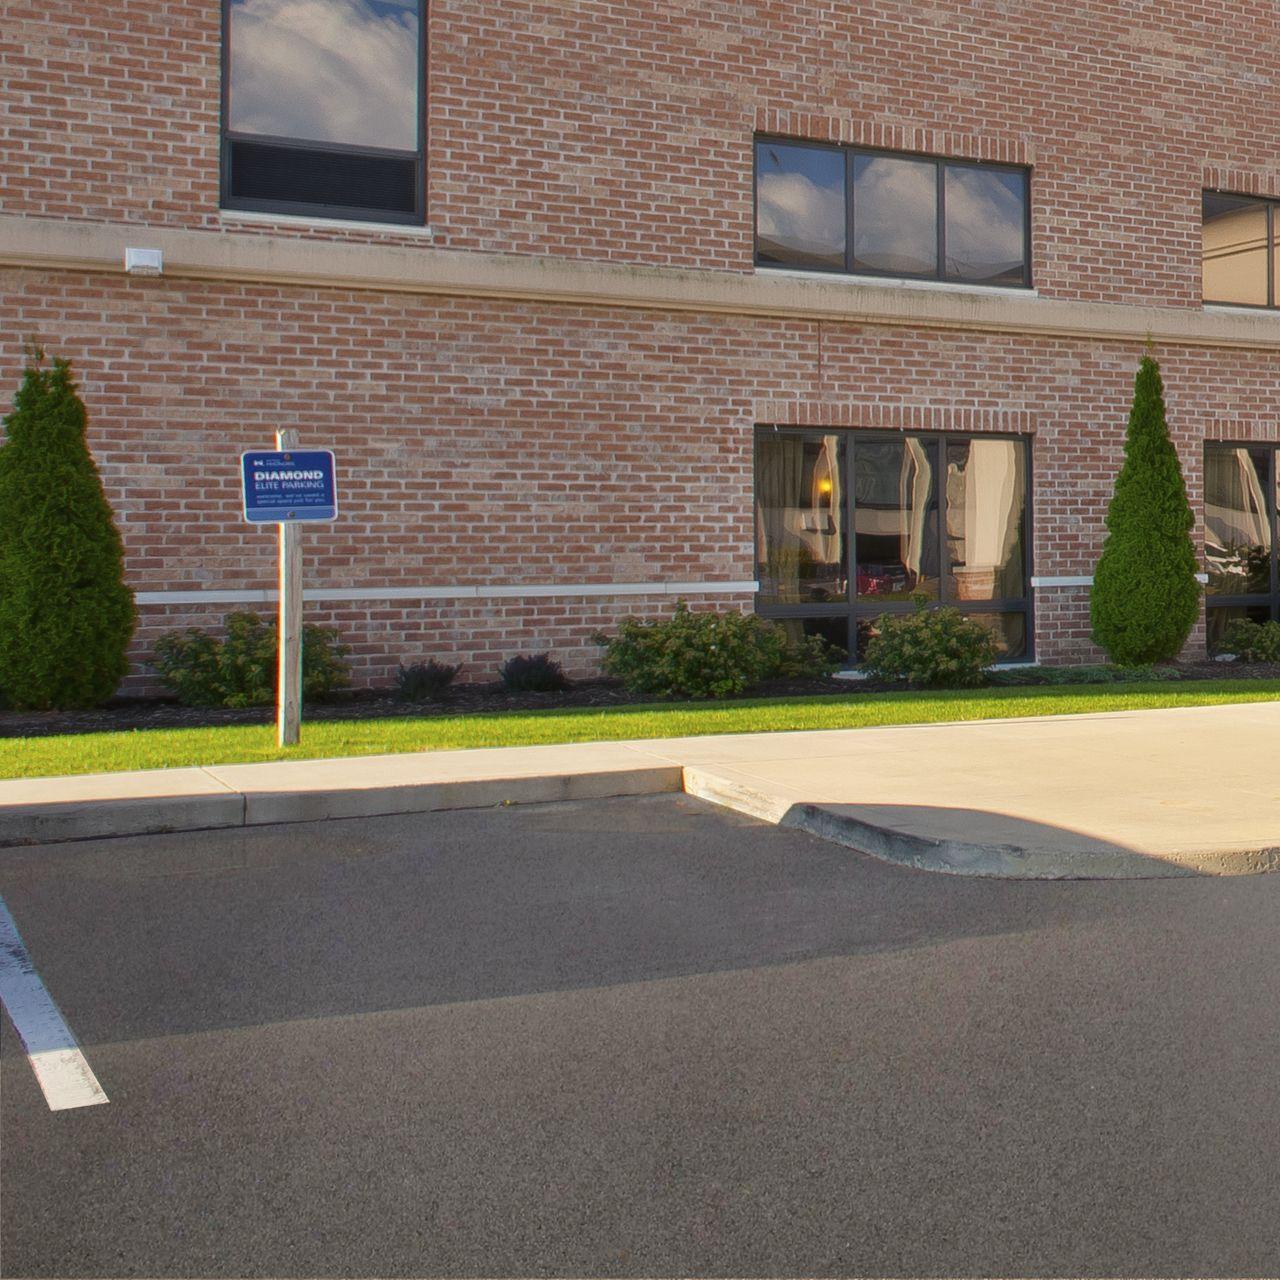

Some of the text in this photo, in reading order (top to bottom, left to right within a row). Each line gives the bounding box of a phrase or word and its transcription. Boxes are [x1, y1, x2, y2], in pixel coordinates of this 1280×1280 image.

[254, 470, 324, 481] DIAMOND
[255, 480, 325, 490] ELITE PARKING
